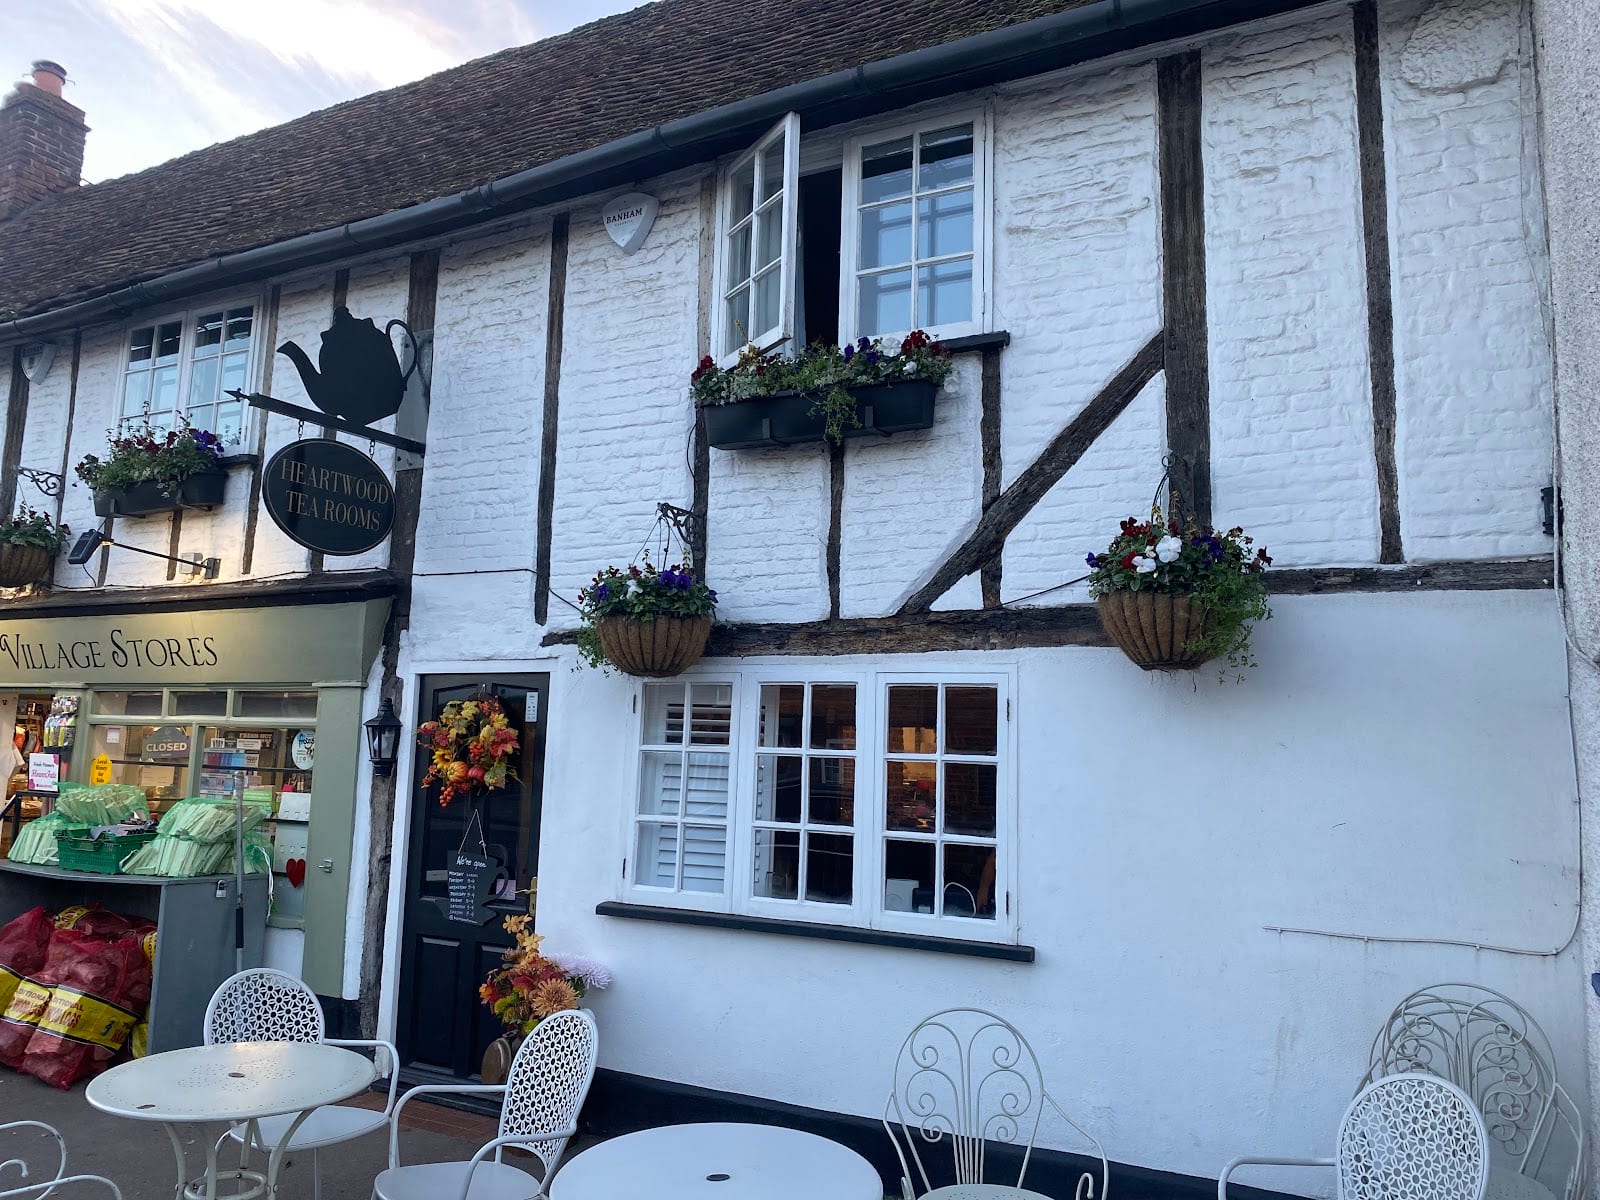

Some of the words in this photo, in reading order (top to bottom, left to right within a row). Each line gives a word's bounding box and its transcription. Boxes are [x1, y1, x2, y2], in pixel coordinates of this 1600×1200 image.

[606, 208, 642, 224] BANHAM
[280, 459, 389, 505] HEARTWOOD
[286, 490, 320, 519] TEA
[324, 499, 381, 531] ROOMS
[0, 633, 105, 670] VILLAGE
[110, 629, 218, 668] STORES
[146, 742, 187, 752] CLOSED
